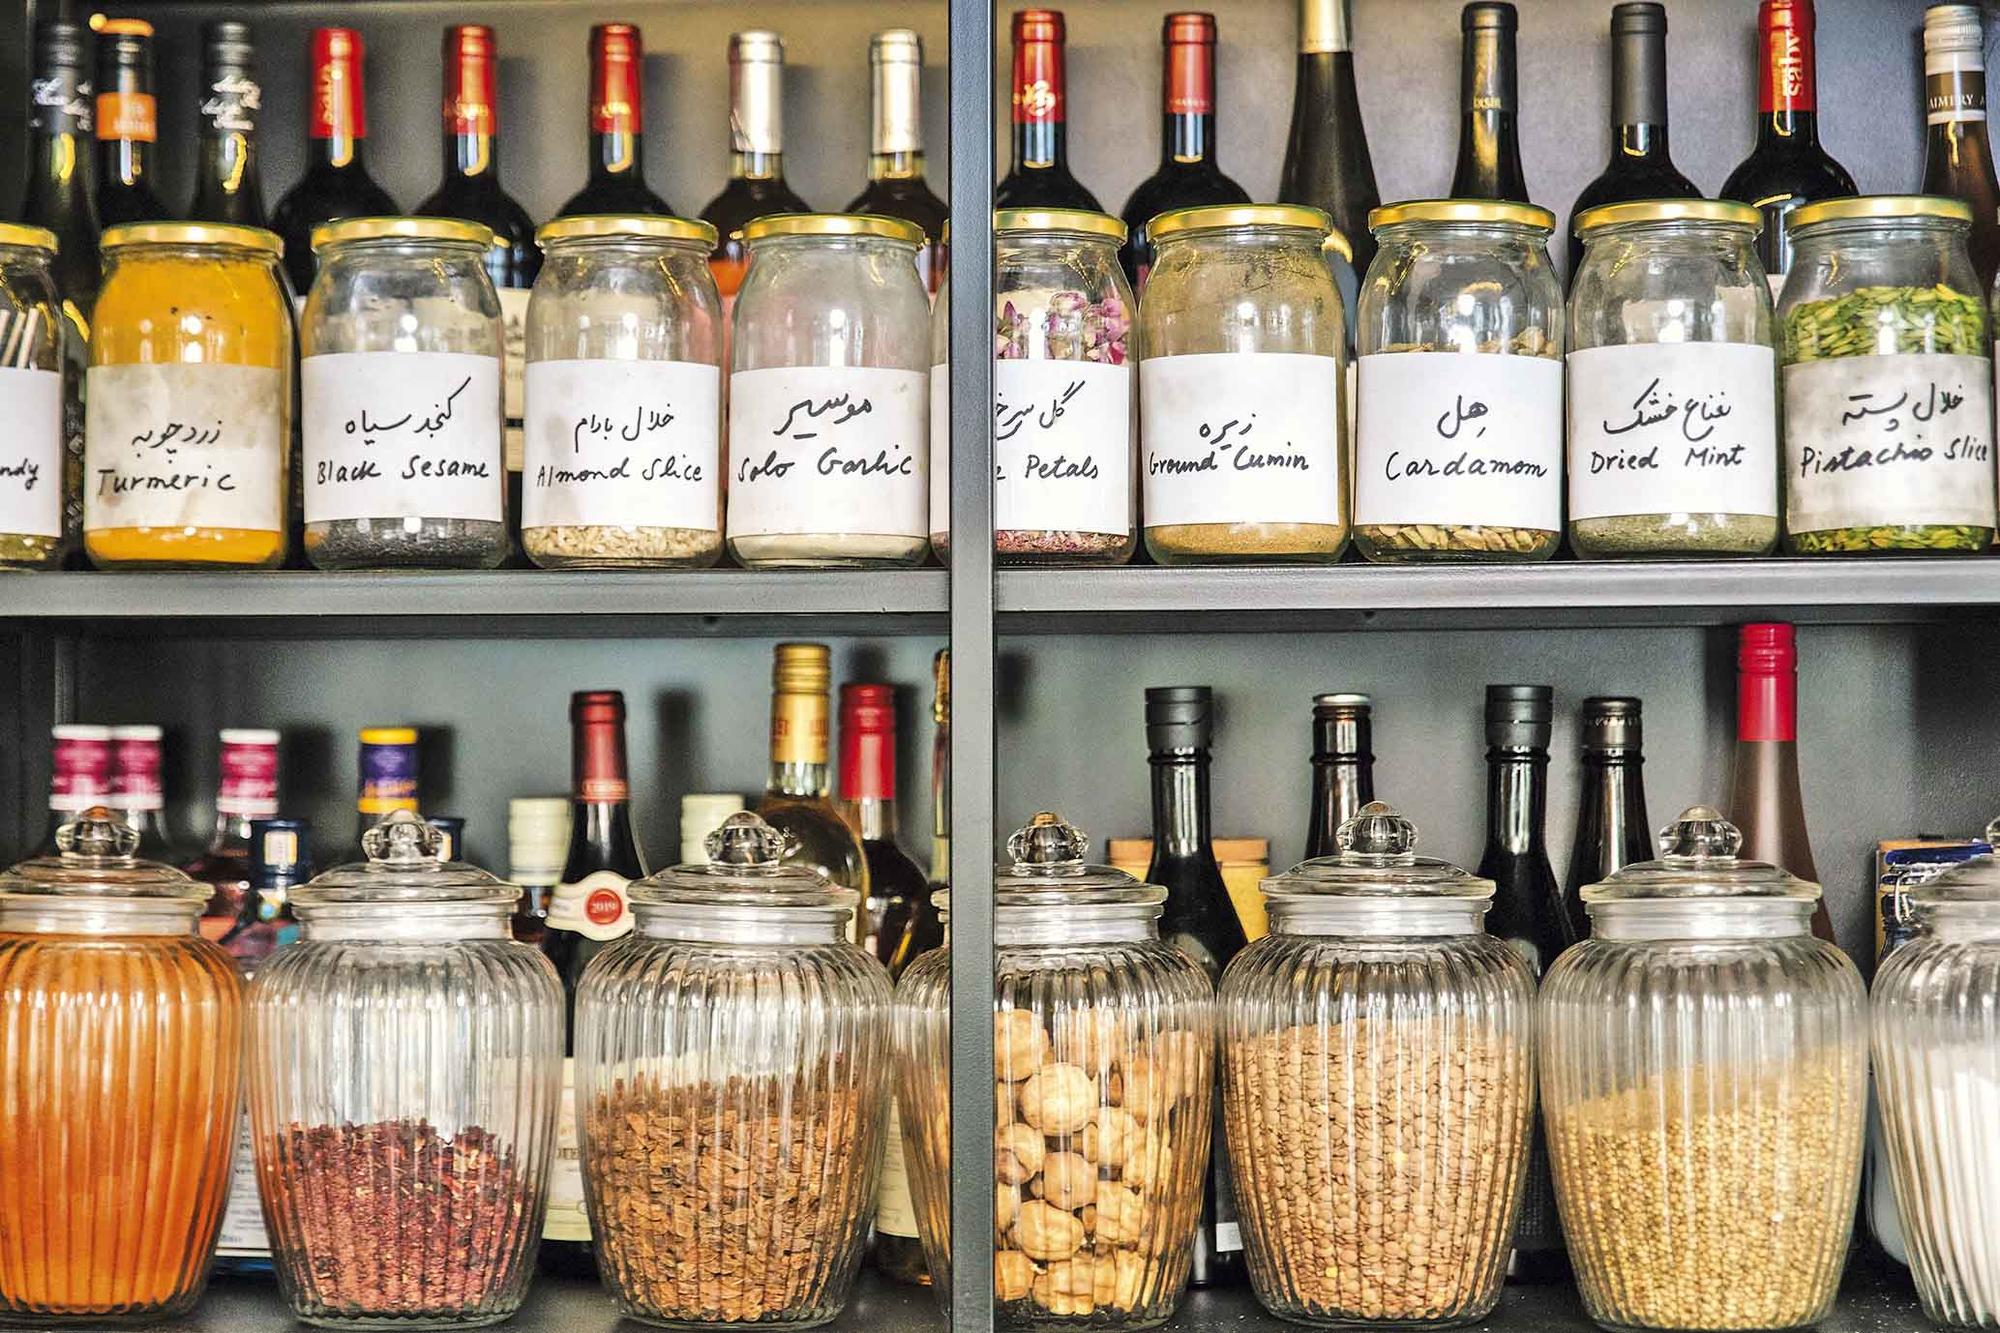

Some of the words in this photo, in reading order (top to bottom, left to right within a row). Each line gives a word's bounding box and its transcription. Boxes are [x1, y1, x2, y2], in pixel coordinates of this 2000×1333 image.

[317, 459, 382, 486] Black
[401, 454, 490, 480] Sesame
[536, 456, 631, 488] Almond
[816, 443, 913, 477] Garlic
[1024, 453, 1099, 480] Petals
[1149, 450, 1219, 476] Ground
[1229, 440, 1310, 471] Cumin
[1385, 451, 1548, 482] Cardamom
[1590, 445, 1659, 475] Dried
[1684, 443, 1746, 468] Mint
[1800, 433, 1934, 479] Pistachio
[97, 461, 237, 497] Turmeric
